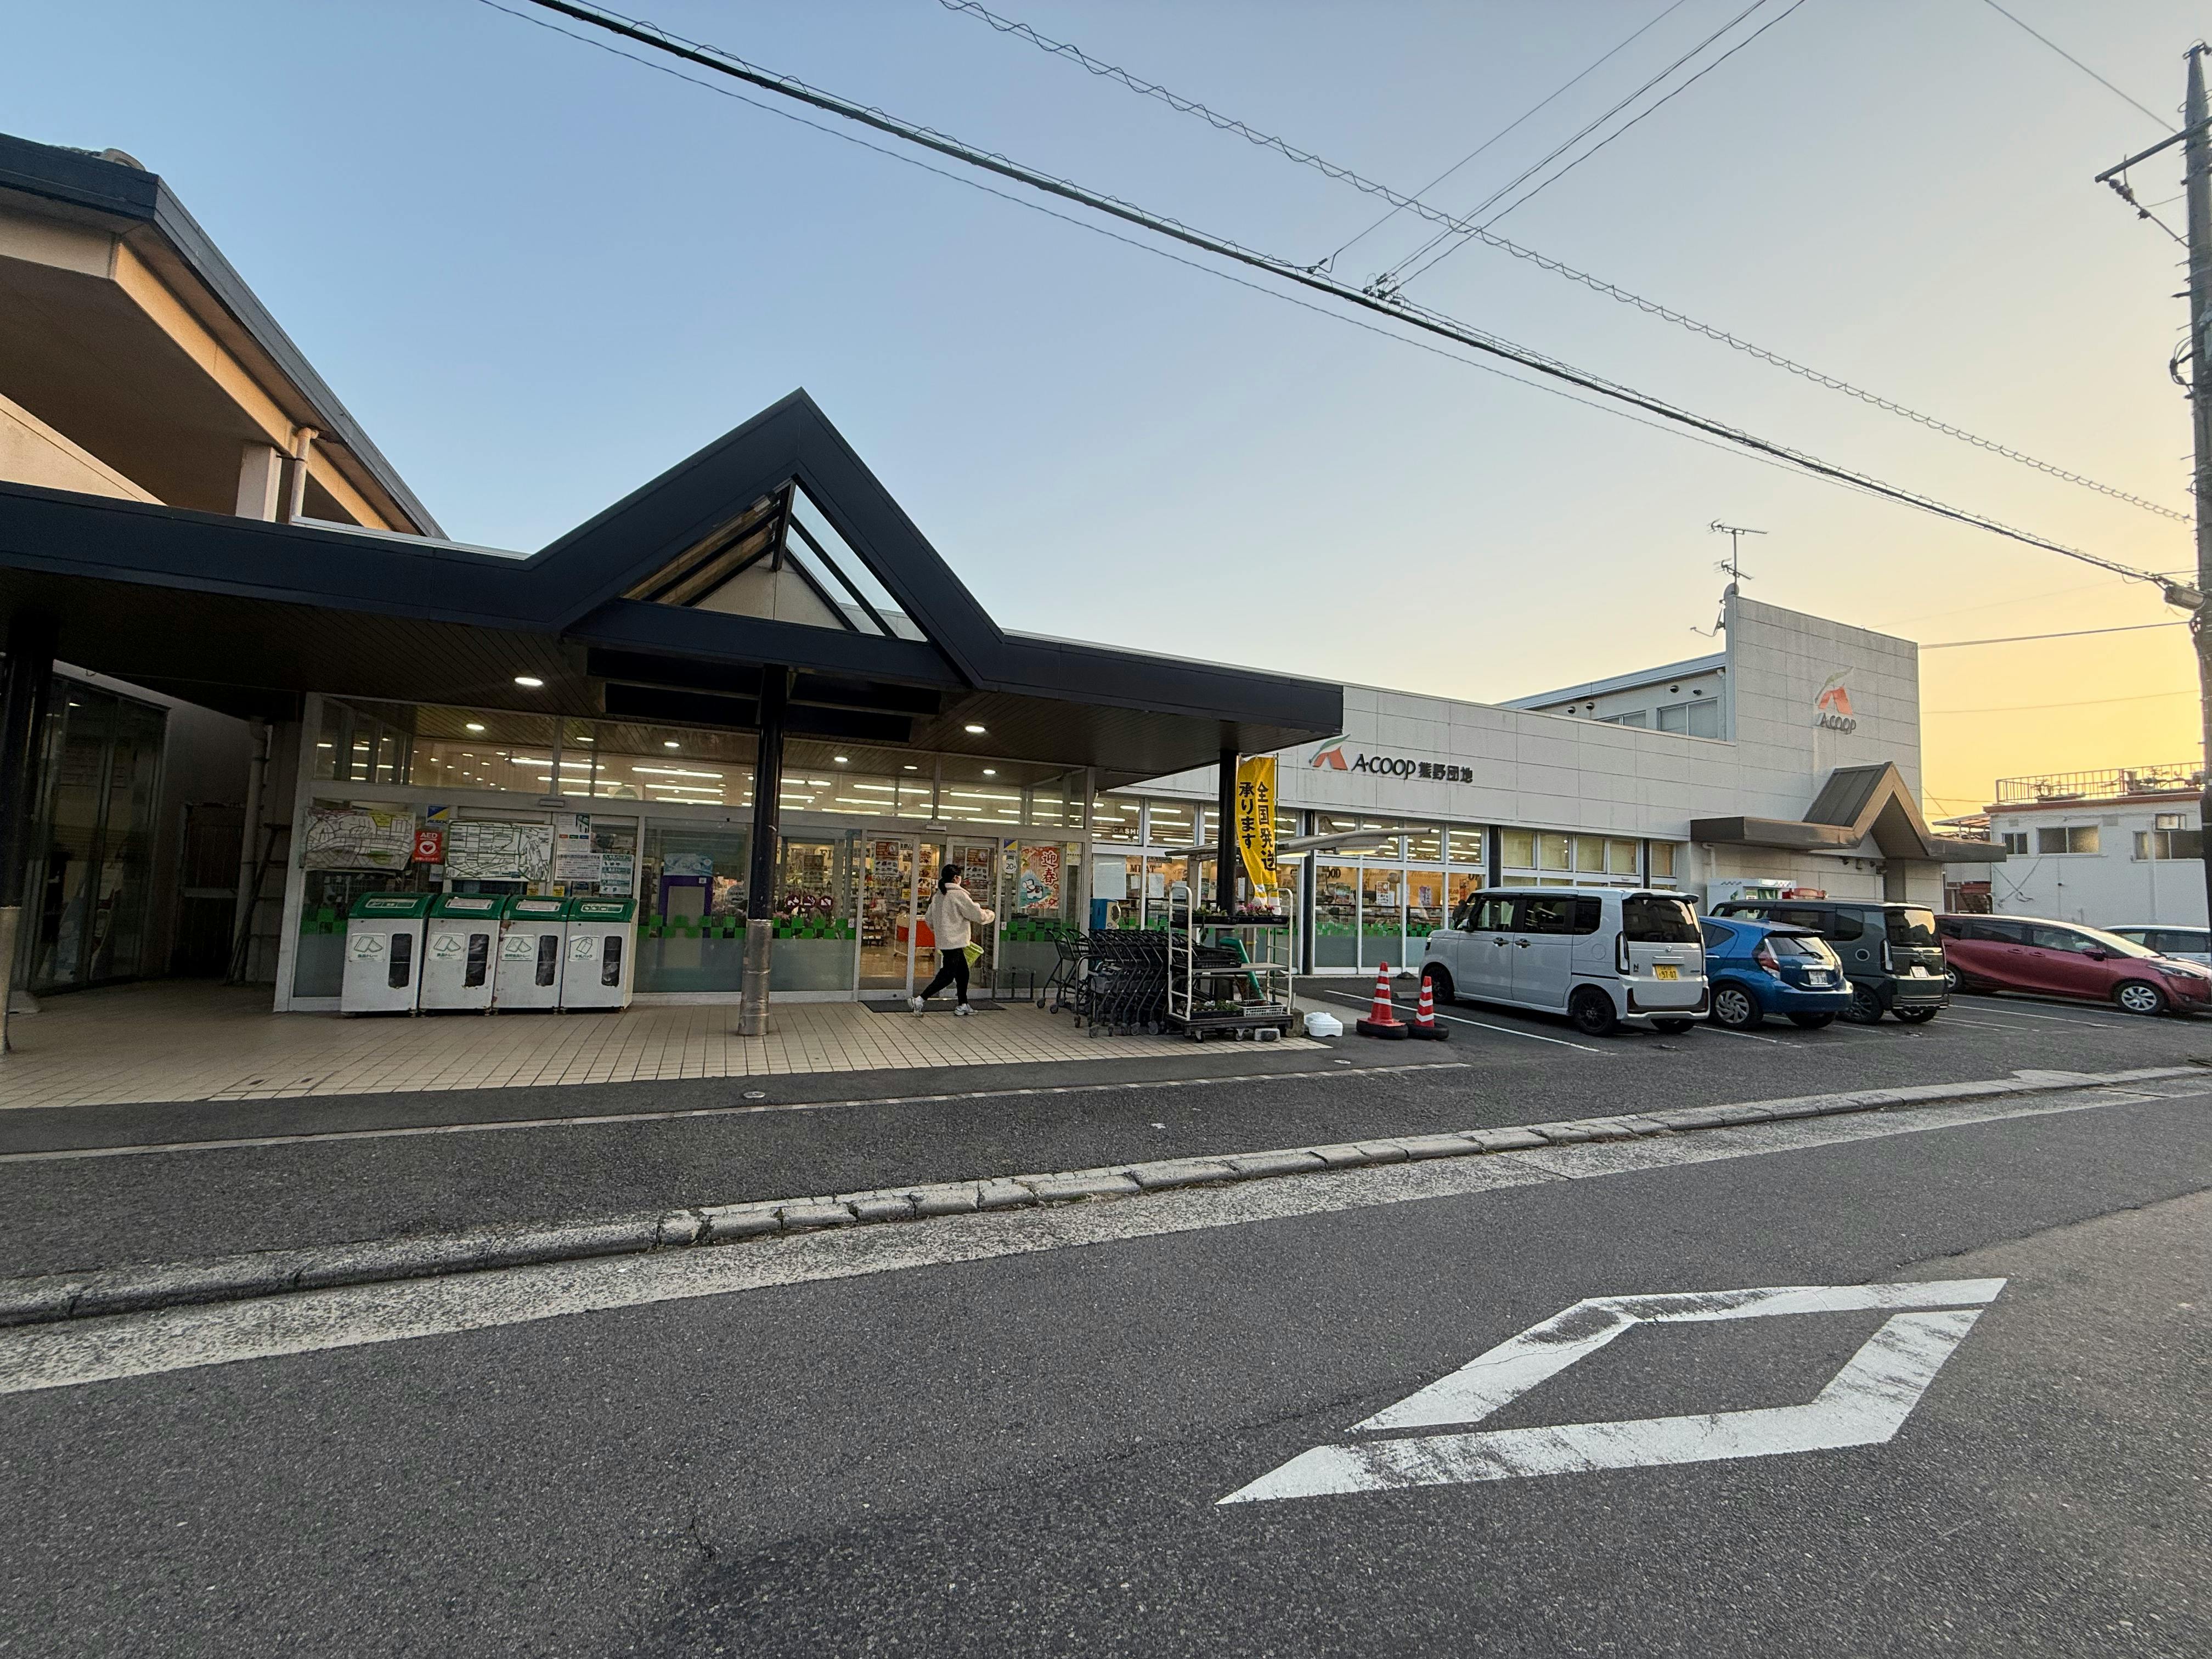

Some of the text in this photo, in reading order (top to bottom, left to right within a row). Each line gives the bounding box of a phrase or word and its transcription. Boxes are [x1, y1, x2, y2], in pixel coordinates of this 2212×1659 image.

[1239, 782, 1256, 849] 承ります
[1257, 781, 1276, 871] 全国発送
[1042, 852, 1057, 883] 迎春
